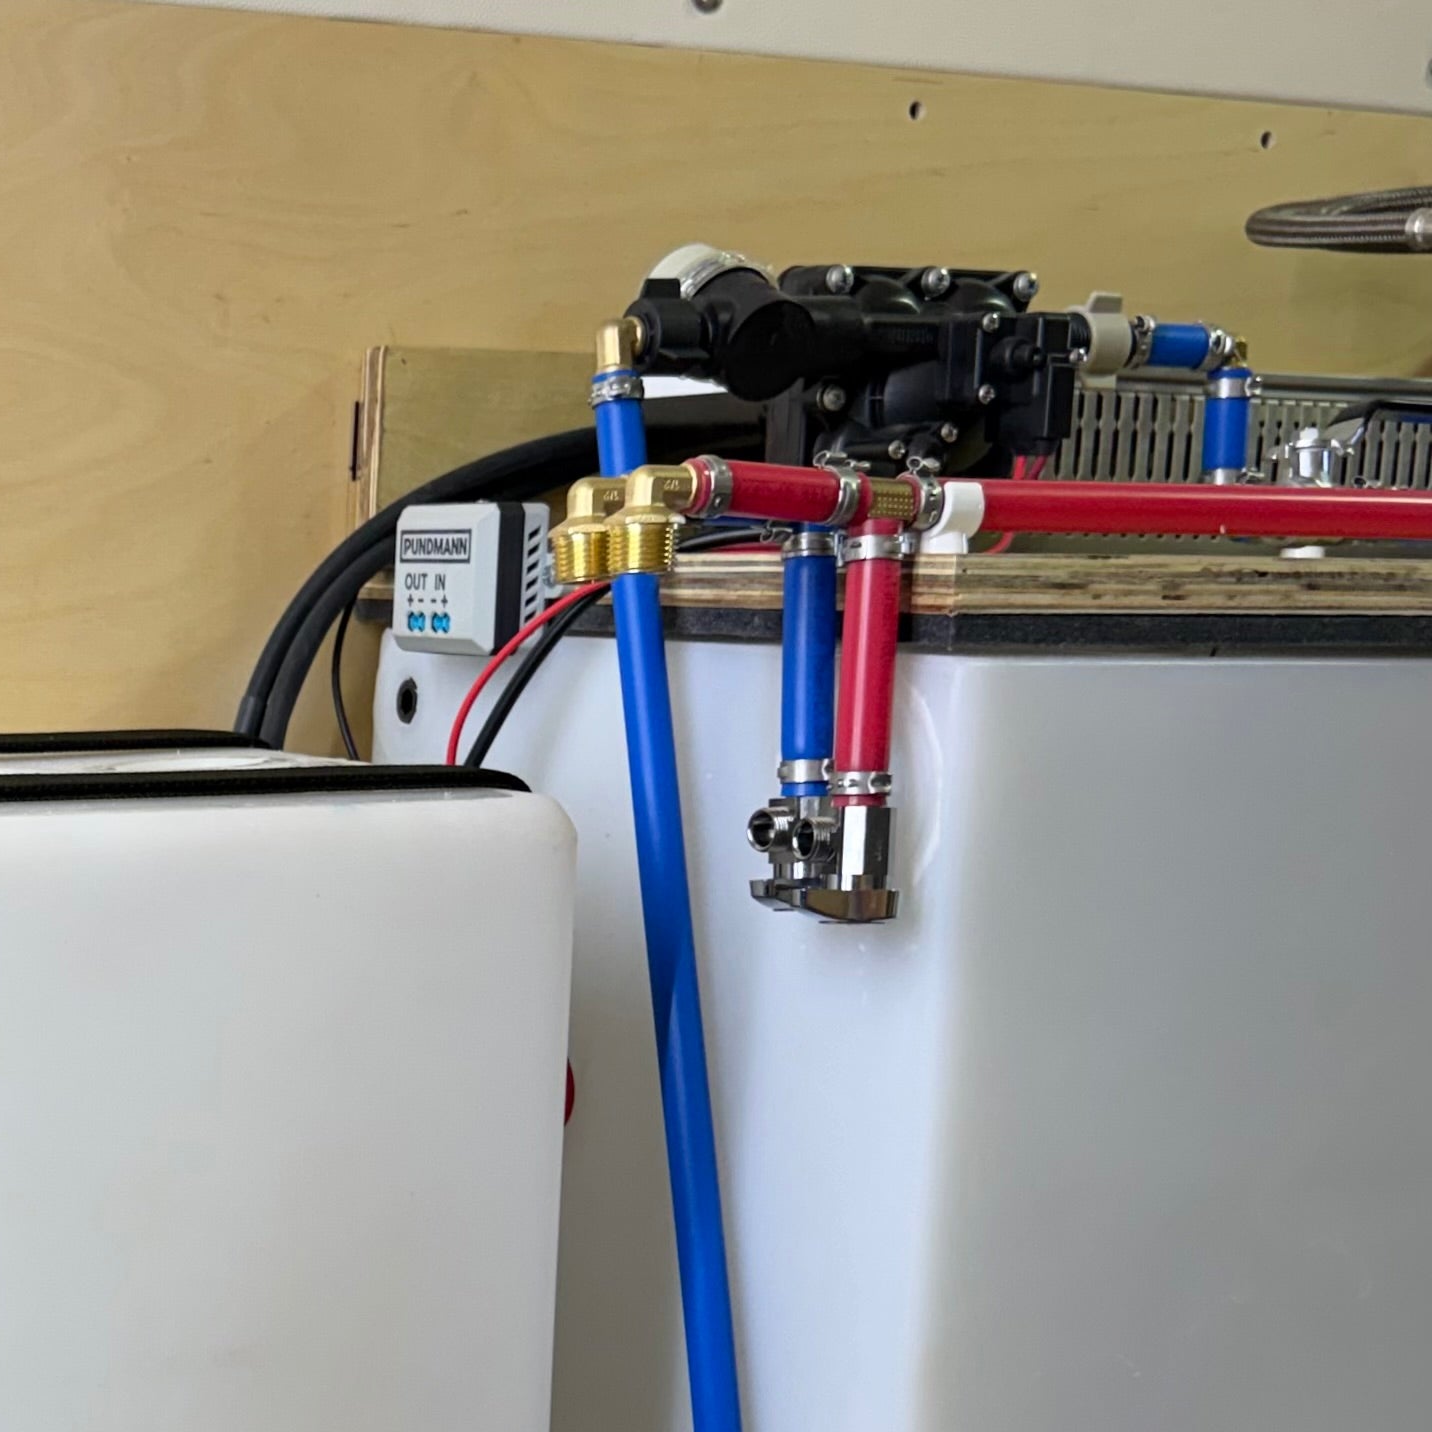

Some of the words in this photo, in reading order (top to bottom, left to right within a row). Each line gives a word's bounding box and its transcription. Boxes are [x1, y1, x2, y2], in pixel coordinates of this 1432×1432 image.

[403, 537, 467, 555] PUNDMANN
[404, 573, 428, 591] OUT
[434, 574, 446, 591] IN
